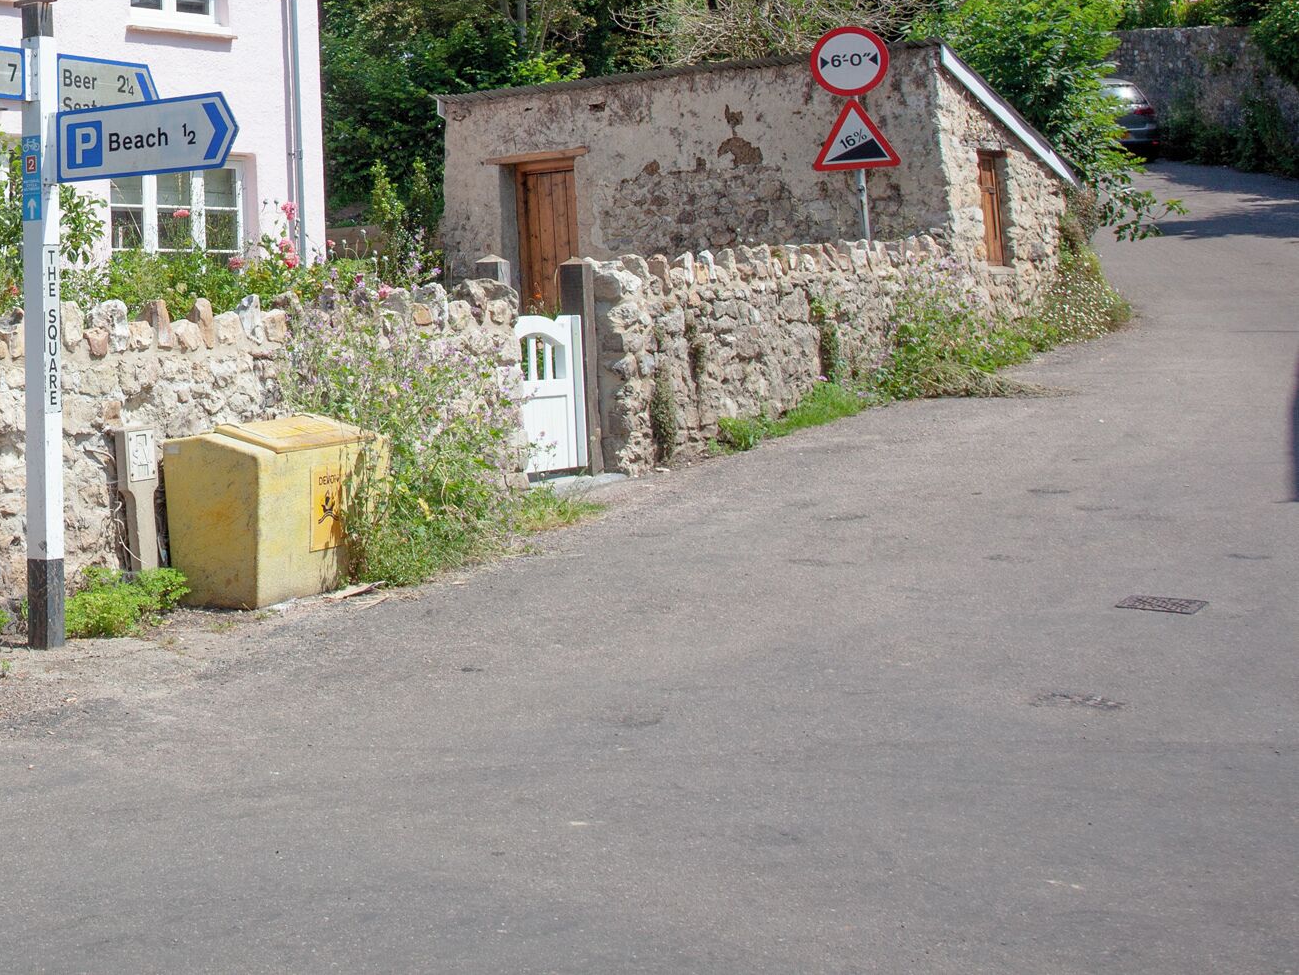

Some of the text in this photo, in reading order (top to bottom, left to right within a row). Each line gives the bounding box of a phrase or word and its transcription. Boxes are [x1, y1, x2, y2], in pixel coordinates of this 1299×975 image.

[7, 62, 18, 82] 7
[62, 68, 97, 90] Beer
[75, 127, 97, 165] P
[108, 127, 169, 152] Beach
[839, 129, 868, 150] 16%
[47, 250, 58, 406] THE SQUARE
